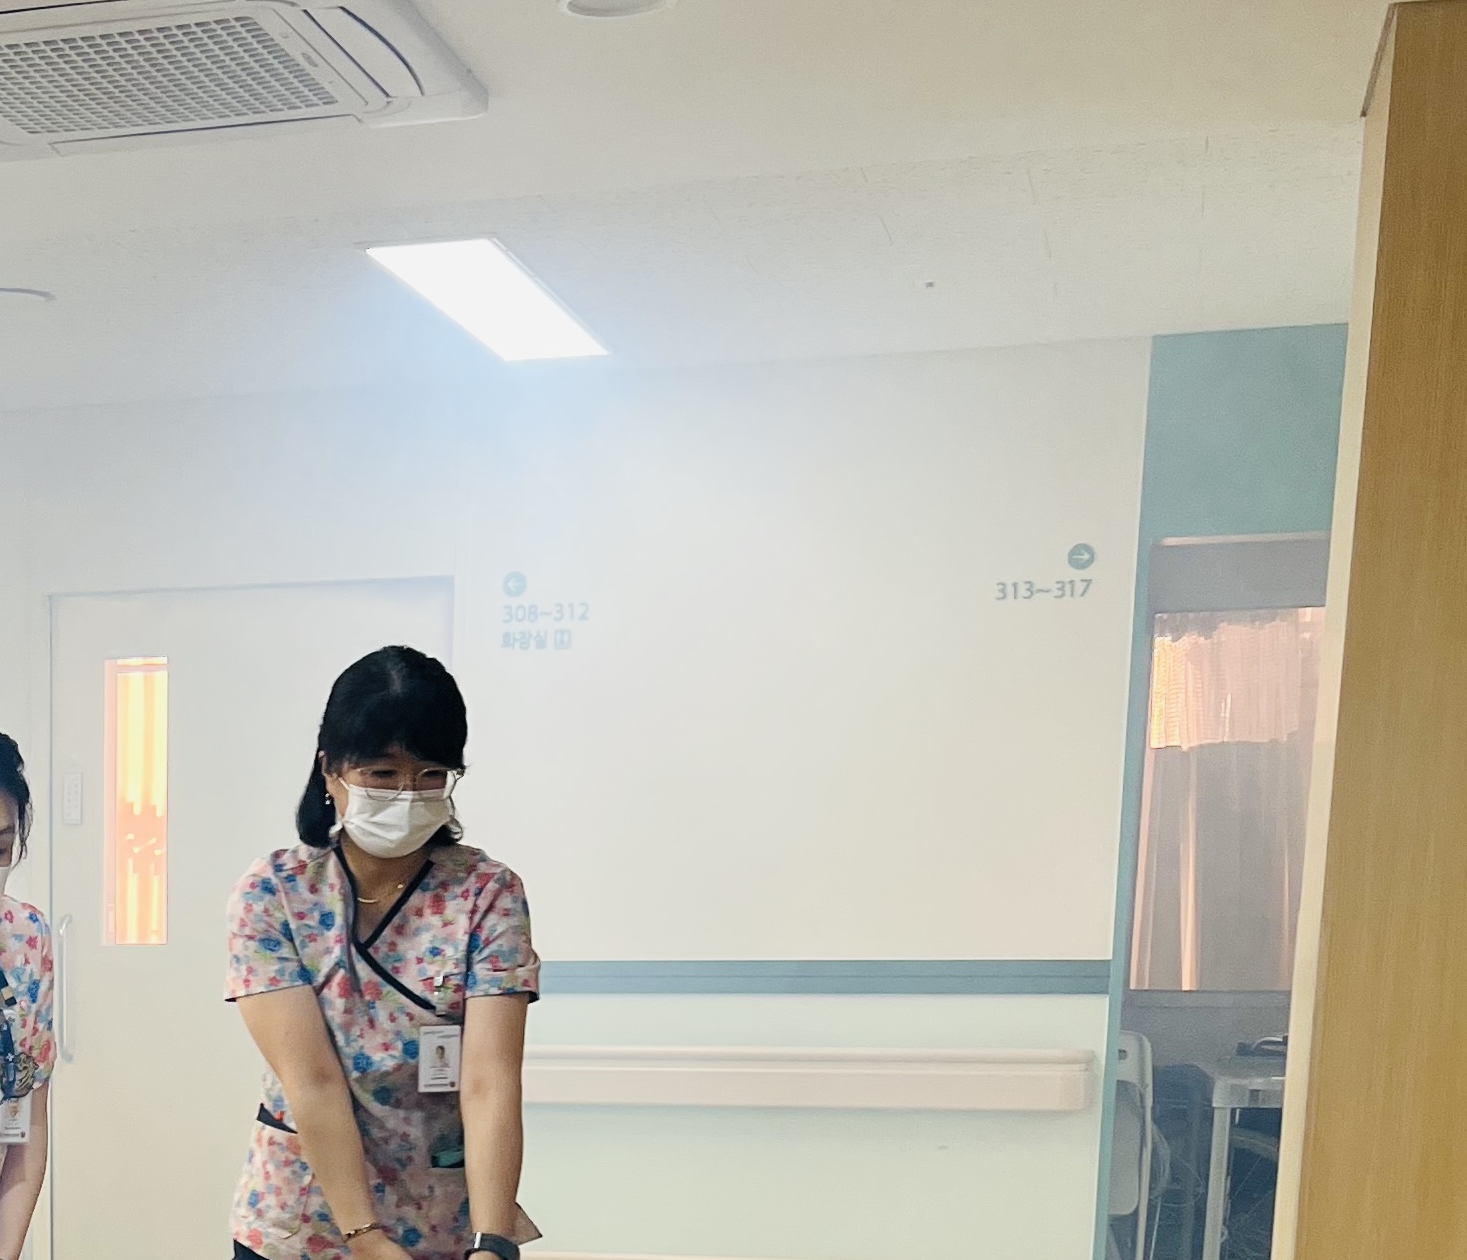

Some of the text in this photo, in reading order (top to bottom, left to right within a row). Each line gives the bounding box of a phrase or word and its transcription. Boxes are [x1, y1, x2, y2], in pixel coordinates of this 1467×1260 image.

[995, 578, 1093, 601] 313~317
[502, 602, 590, 624] 308~312
[501, 629, 548, 651] 화장실
